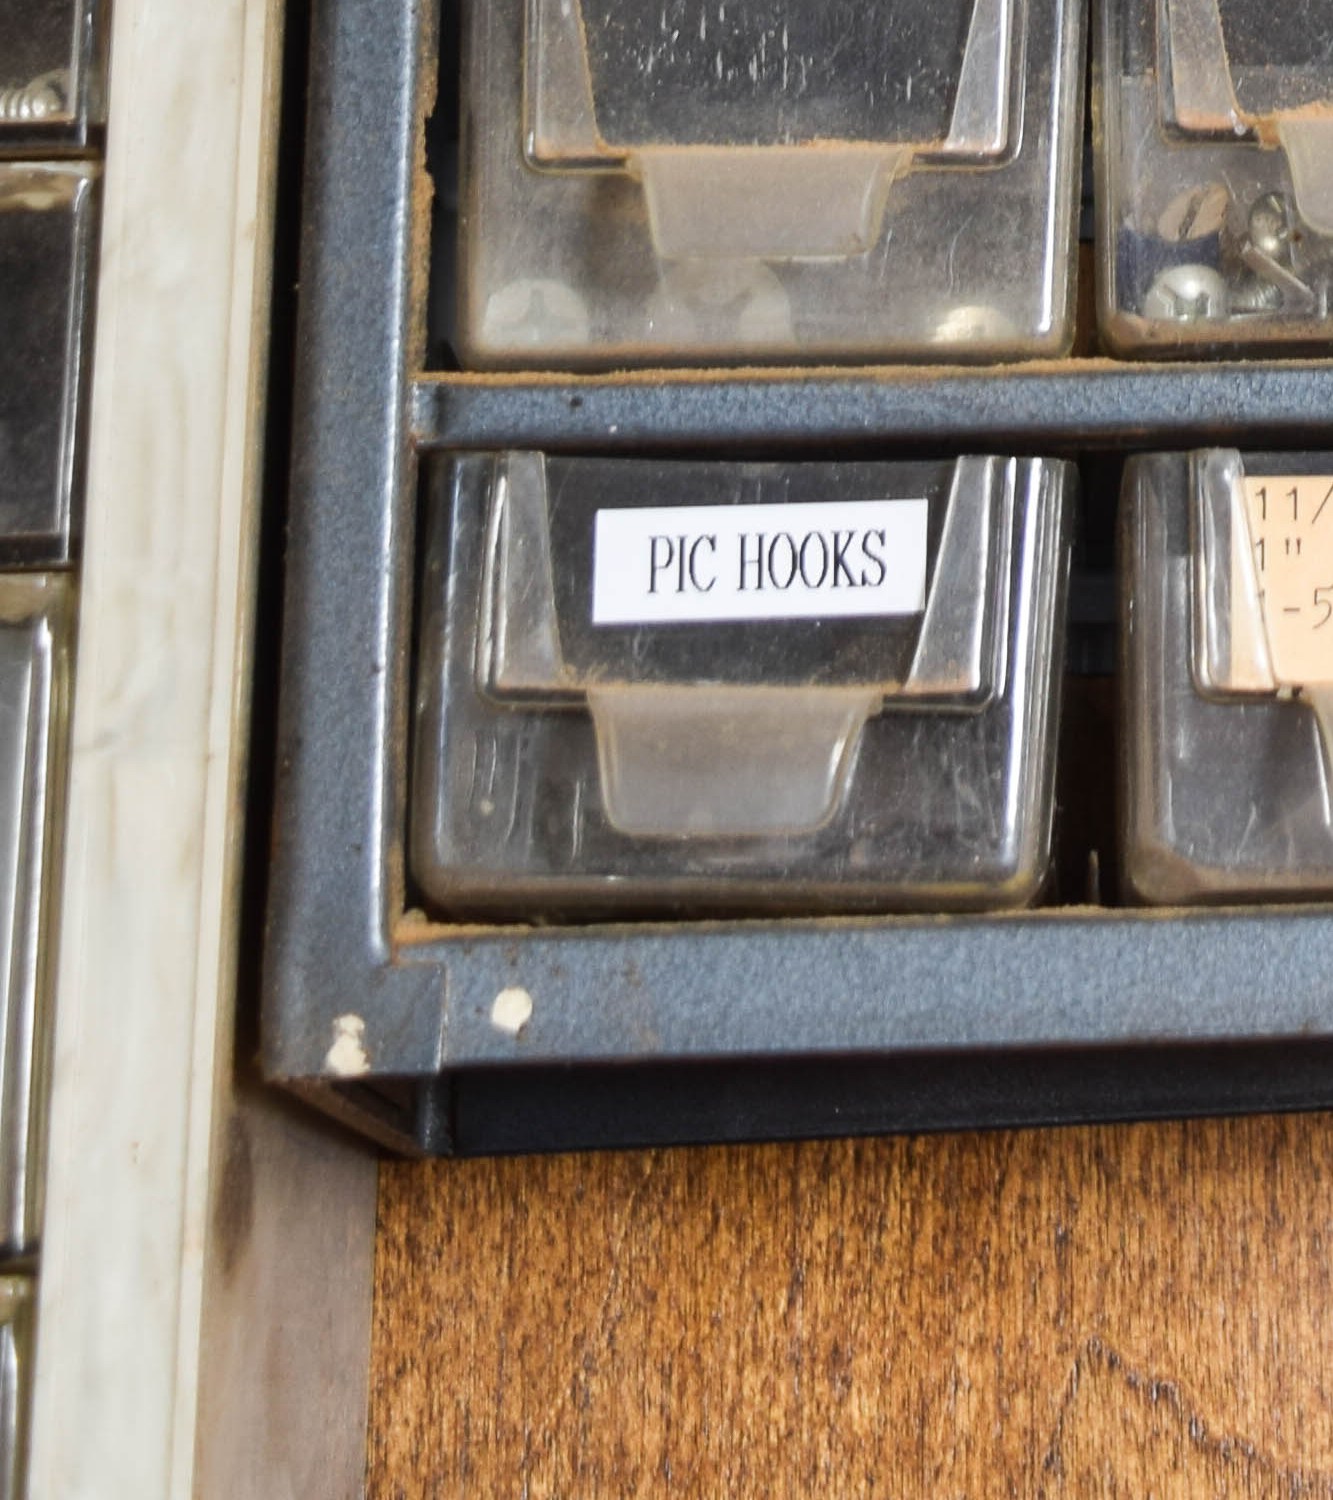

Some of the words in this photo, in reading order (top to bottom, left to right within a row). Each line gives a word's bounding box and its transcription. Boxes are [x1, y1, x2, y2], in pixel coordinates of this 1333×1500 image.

[648, 533, 718, 594] PIC
[736, 528, 887, 593] HOOKS
[1255, 535, 1302, 572] 1"
